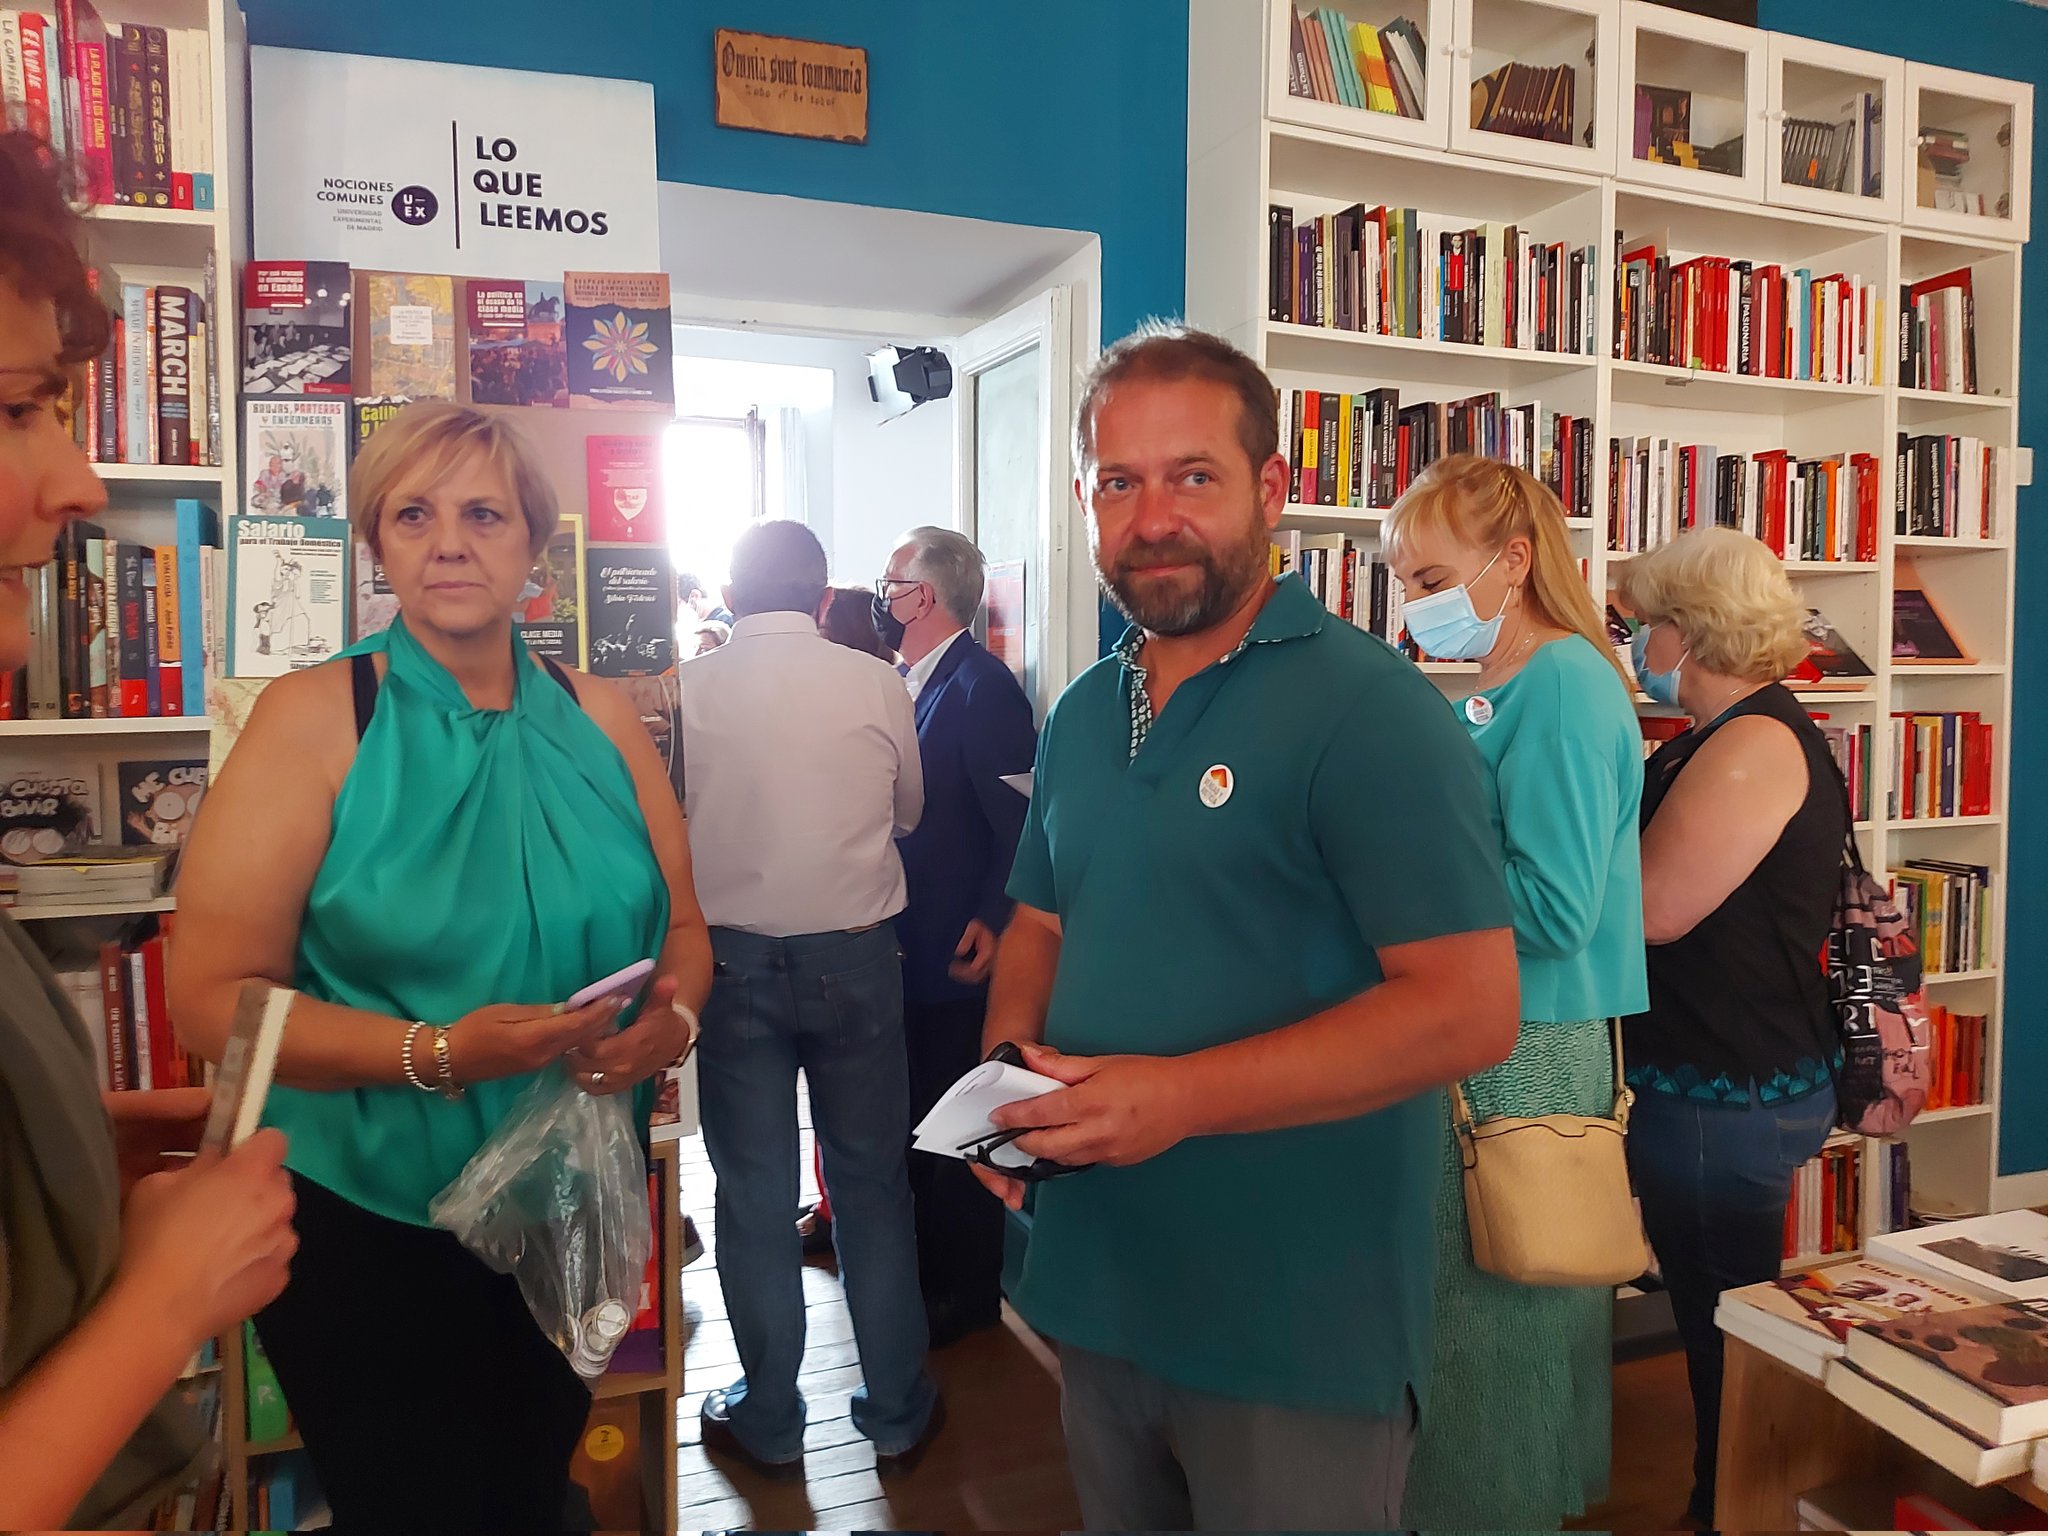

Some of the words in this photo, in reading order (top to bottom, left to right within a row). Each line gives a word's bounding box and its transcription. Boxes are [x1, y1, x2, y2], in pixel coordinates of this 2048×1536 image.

[3, 20, 11, 35] LA
[722, 40, 767, 82] Omnia
[801, 60, 862, 95] communia
[476, 136, 517, 163] LO
[323, 178, 394, 193] NOCIONES
[473, 169, 543, 198] QUE
[316, 191, 384, 205] COMUNES
[332, 216, 382, 225] EXPERIMENTAL
[337, 208, 383, 217] UNIVERSIDAD
[404, 206, 426, 218] EX
[480, 201, 609, 236] LEEMOS
[1741, 304, 1751, 364] PASIONARIA
[1900, 312, 1910, 363] surrealismo
[159, 295, 189, 397] MARCH
[294, 403, 341, 415] PARTERAS
[272, 415, 333, 425] ENFERMERAS
[1896, 454, 1906, 513] situacionismo
[237, 519, 306, 538] Salario
[268, 538, 298, 546] Trabajo
[168, 766, 209, 786] CUE
[10, 777, 89, 798] CUESTA
[1856, 1262, 1904, 1279] Cine
[1906, 1278, 1972, 1305] Crush
